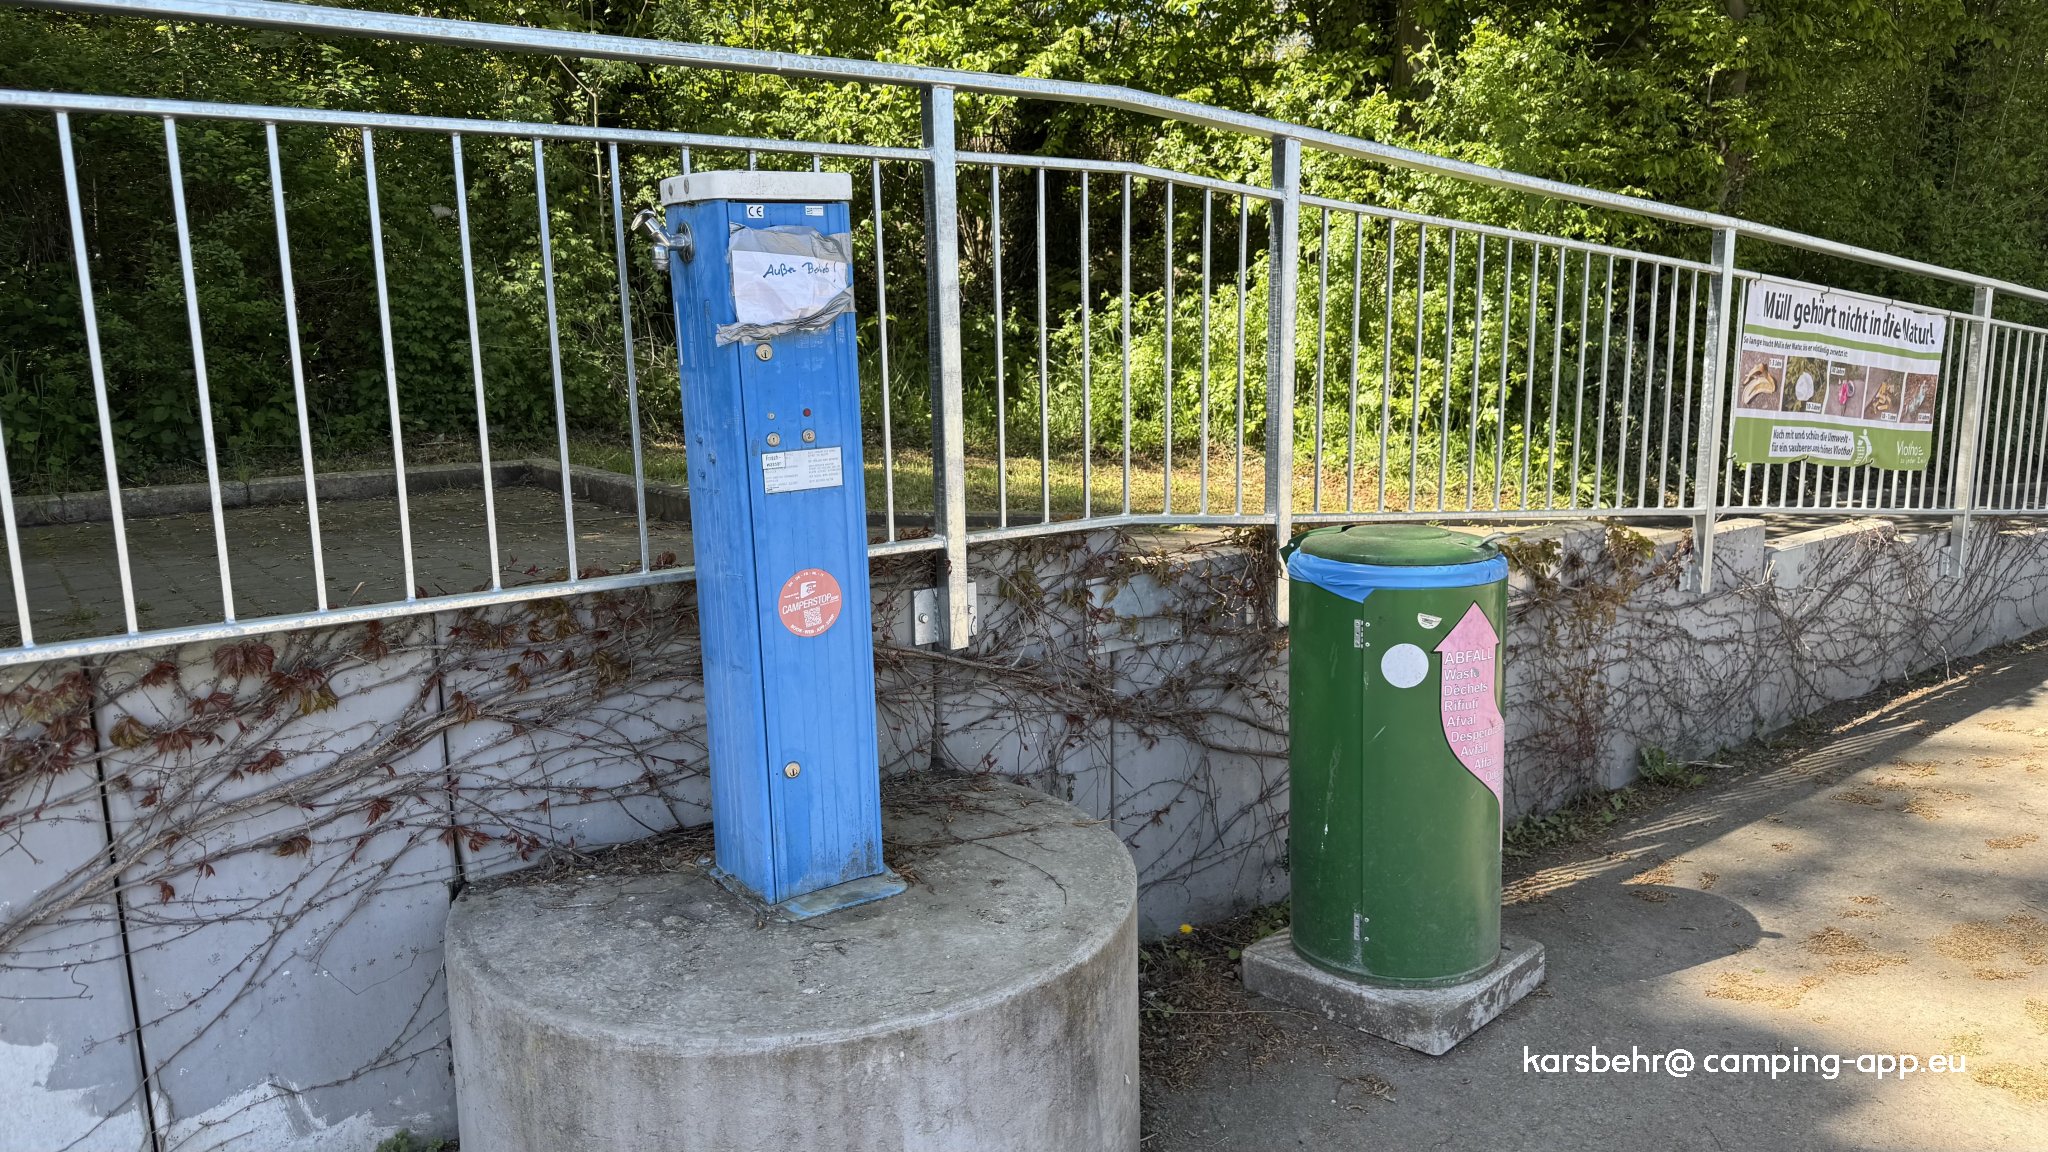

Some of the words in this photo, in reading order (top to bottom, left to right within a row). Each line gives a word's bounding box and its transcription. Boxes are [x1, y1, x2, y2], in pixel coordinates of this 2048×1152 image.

[763, 263, 796, 278] Außer
[1763, 291, 1792, 321] Müll
[1793, 297, 1836, 329] gehört
[1838, 305, 1868, 333] nicht
[1869, 309, 1881, 336] in
[1882, 312, 1901, 339] die
[1903, 317, 1935, 345] Natur!
[1785, 430, 1794, 439] mit
[1794, 430, 1805, 440] und
[1779, 442, 1788, 452] ein
[1444, 647, 1493, 665] ABFALL
[1446, 714, 1476, 727] Afval
[1460, 742, 1488, 756] Avfall
